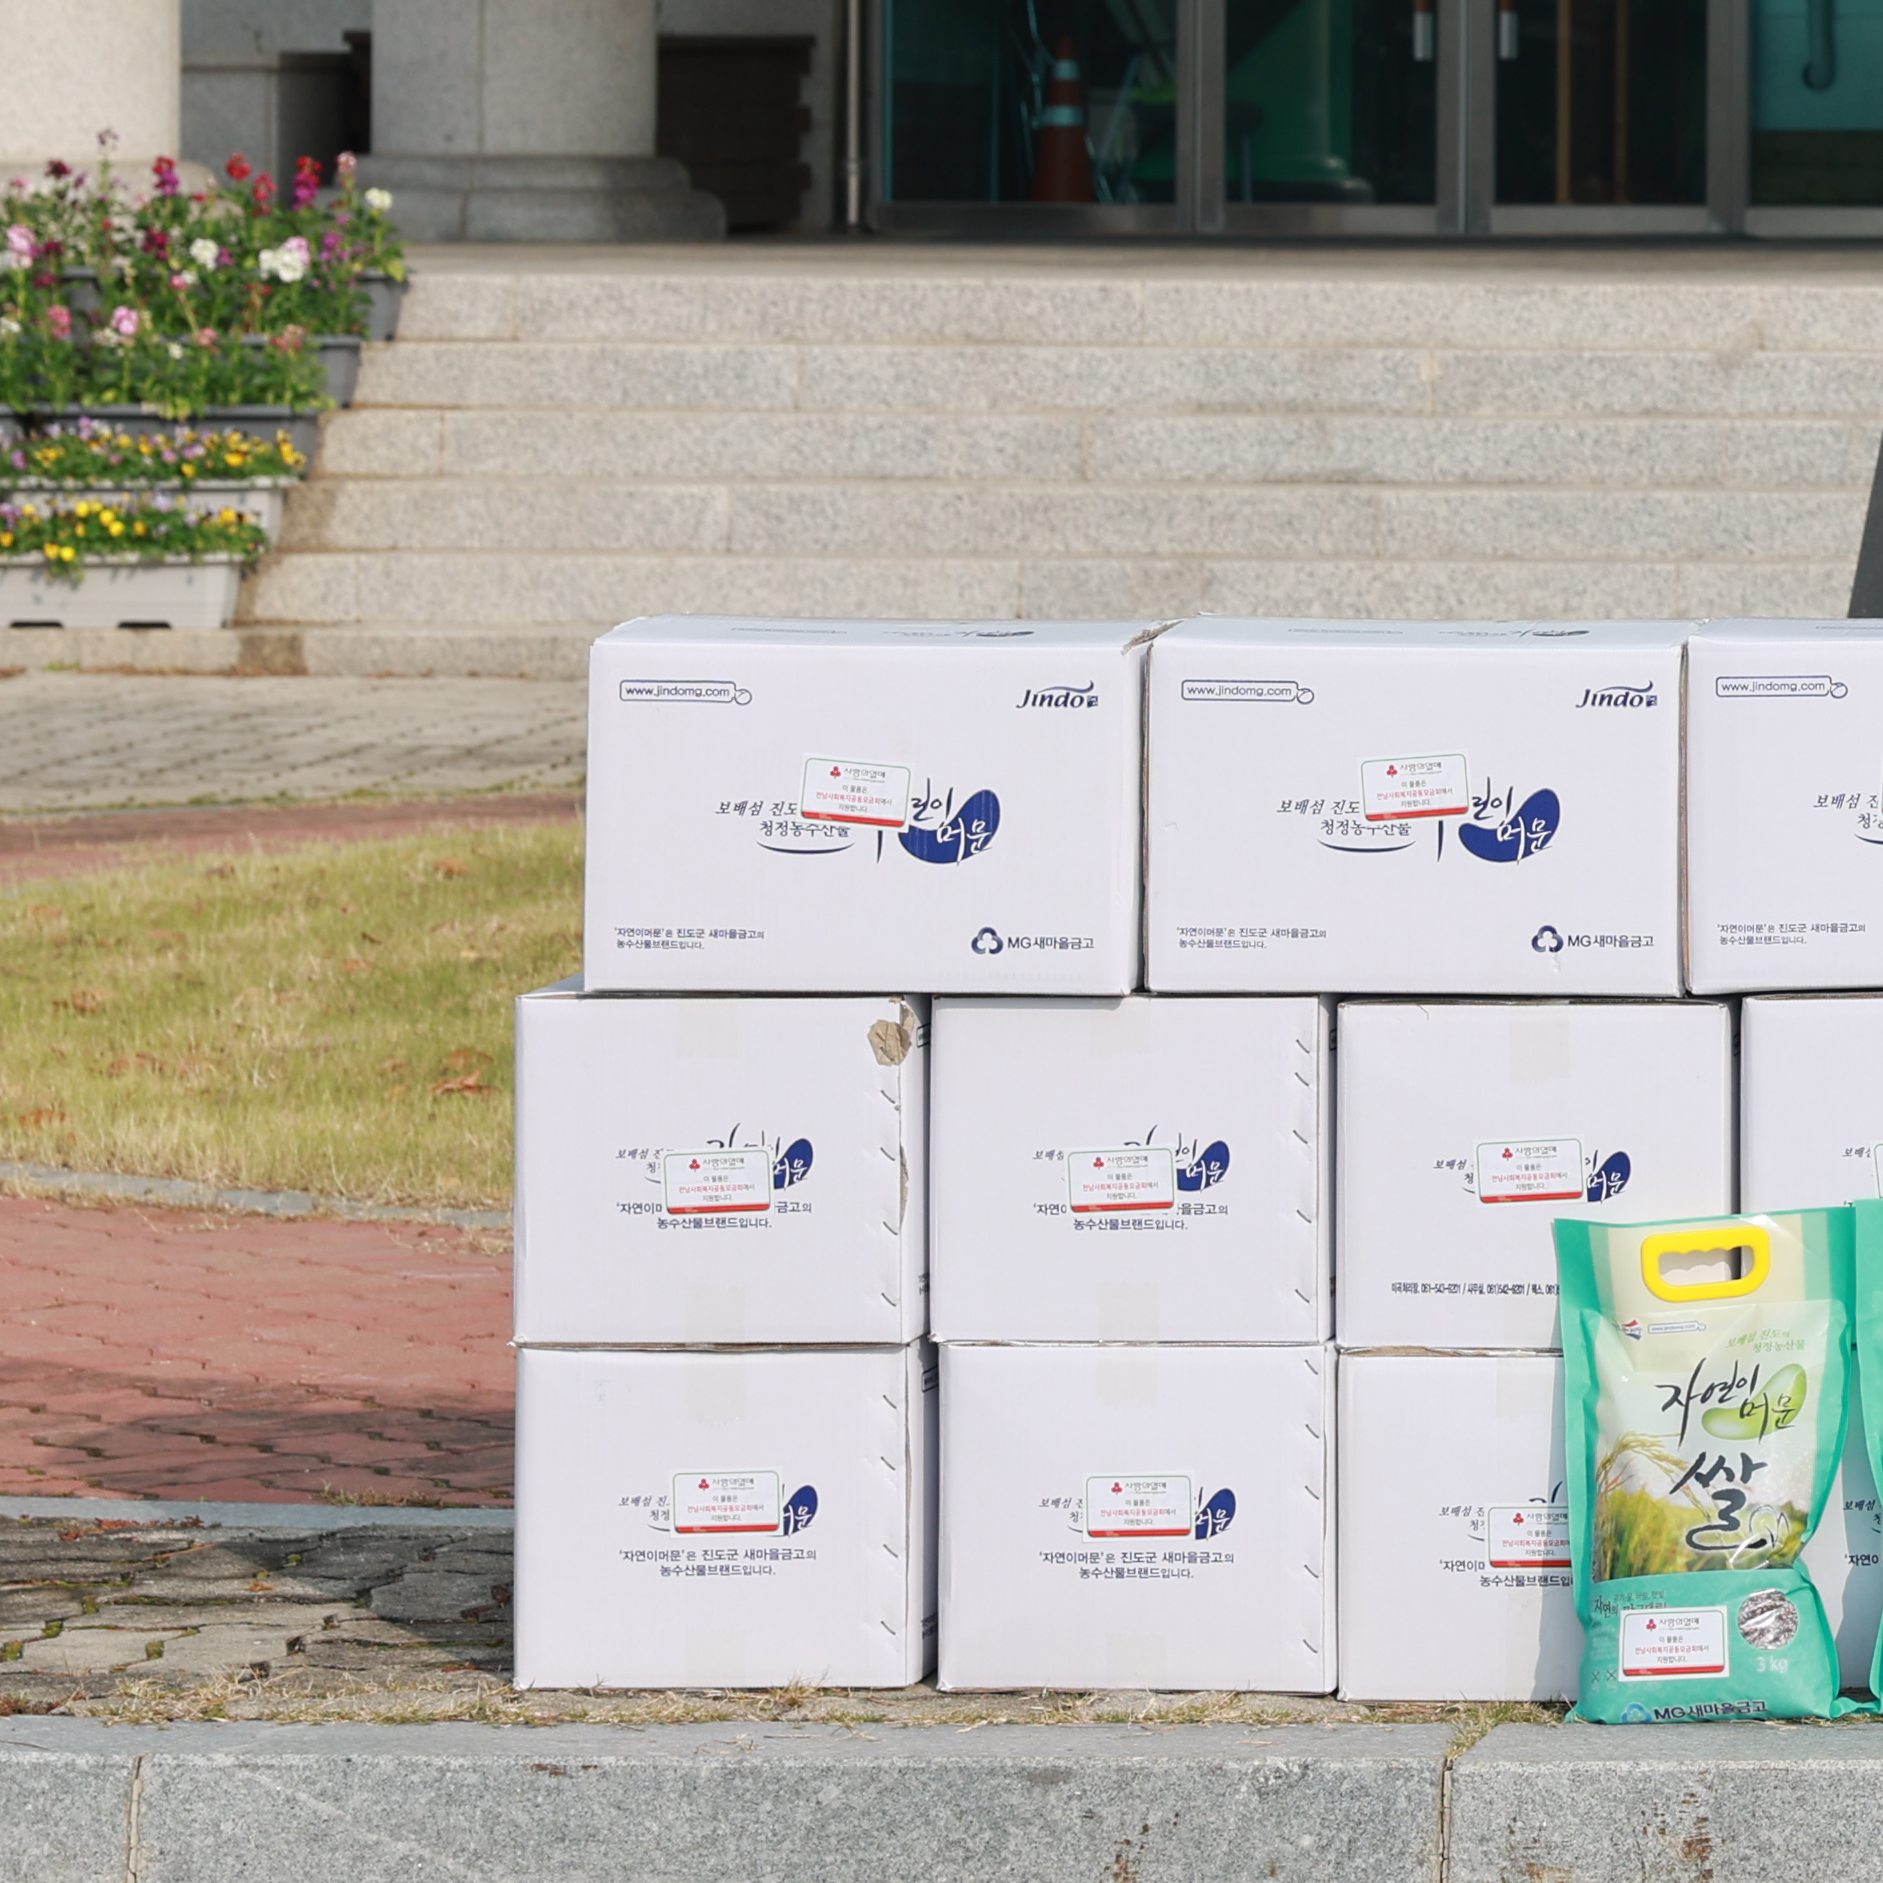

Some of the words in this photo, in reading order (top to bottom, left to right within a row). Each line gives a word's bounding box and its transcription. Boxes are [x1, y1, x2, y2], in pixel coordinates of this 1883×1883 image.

[625, 685, 730, 698] www.jindomg.com
[1187, 686, 1292, 697] www.jindomg.com
[1721, 681, 1826, 693] www.jindomg.com
[1015, 689, 1085, 709] Jindo
[1575, 686, 1648, 708] Jindo
[1276, 798, 1325, 815] 보배섬
[1813, 793, 1862, 810] 보배섬
[715, 800, 764, 817] 보배섬
[676, 928, 706, 939] 진도군
[708, 928, 765, 940] 새마을금고의
[1238, 927, 1268, 938] 진도군
[1270, 927, 1327, 939] 새마을금고의
[1778, 923, 1808, 934] 진도군
[1810, 922, 1866, 934] 새마을금고의
[616, 939, 702, 950] 농수산물브랜드입니다.
[1179, 938, 1265, 949] 농수산물브랜드입니다.
[1719, 935, 1805, 946] 농수산물브랜드입니다.
[656, 1216, 769, 1230] 농수산물브랜드입니다.
[1072, 1218, 1188, 1231] 농수산물브랜드입니다.
[1669, 1452, 1768, 1552] 쌀
[701, 1548, 739, 1562] 진도군
[743, 1547, 817, 1561] 새마을금고의
[1120, 1551, 1158, 1564] 진도군
[1161, 1551, 1234, 1564] 새마을금고의
[659, 1564, 773, 1577] 농수산물브랜드입니다.
[1079, 1566, 1194, 1580] 농수산물브랜드입니다.
